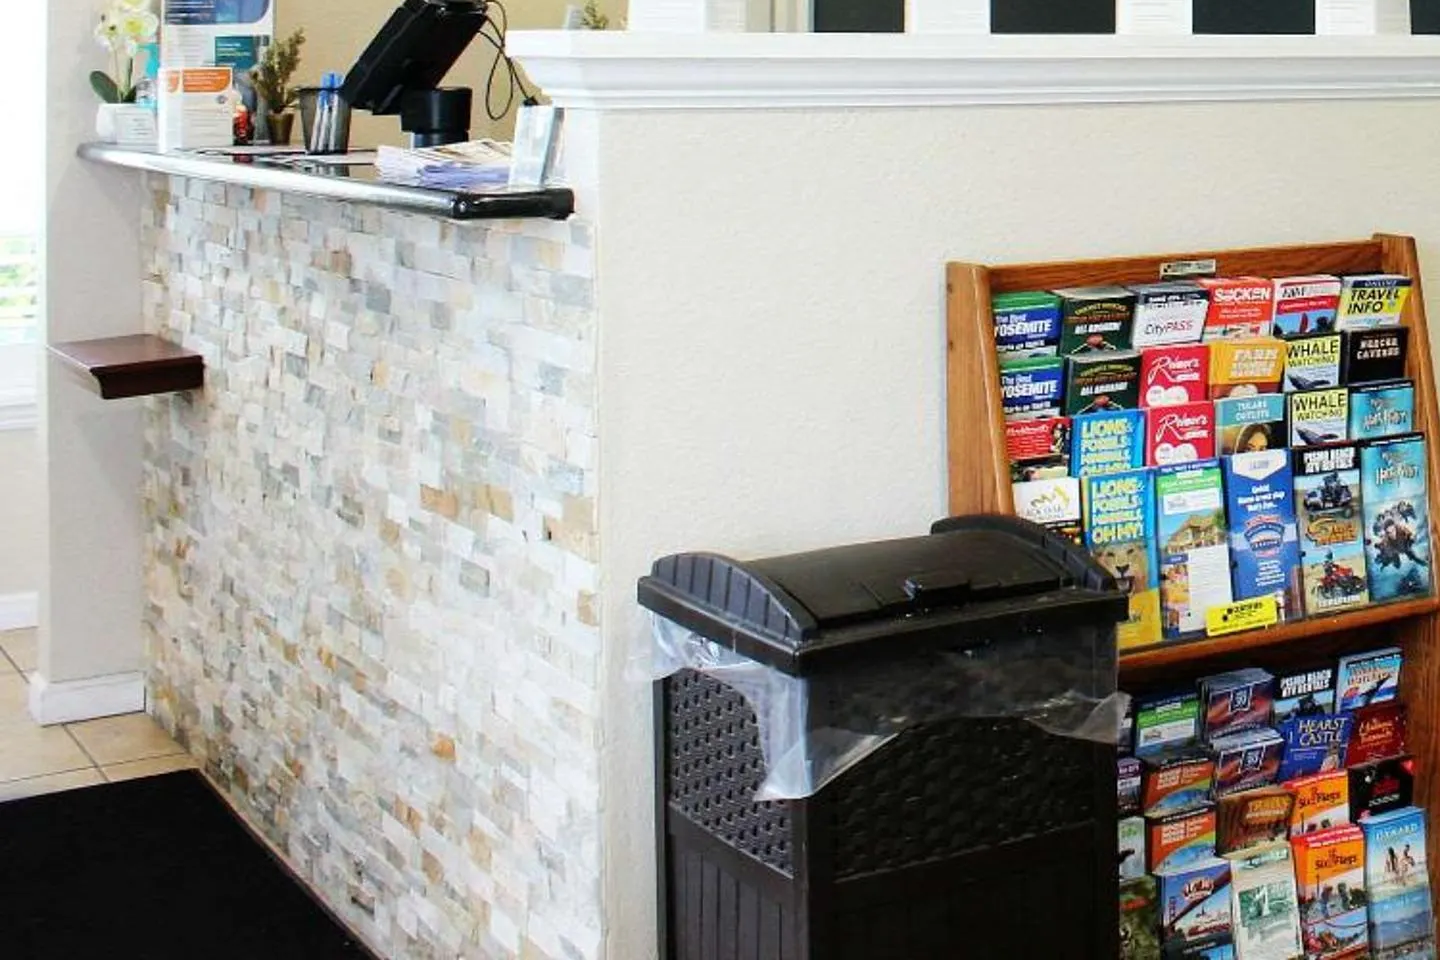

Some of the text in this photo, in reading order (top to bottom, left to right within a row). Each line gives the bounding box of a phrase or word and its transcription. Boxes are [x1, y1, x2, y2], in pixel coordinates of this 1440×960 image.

[1351, 288, 1400, 302] TRAVEL
[1347, 301, 1383, 315] INFO
[1288, 339, 1339, 358] WHALE
[1294, 393, 1346, 411] WHALE
[1299, 717, 1348, 733] HEARST
